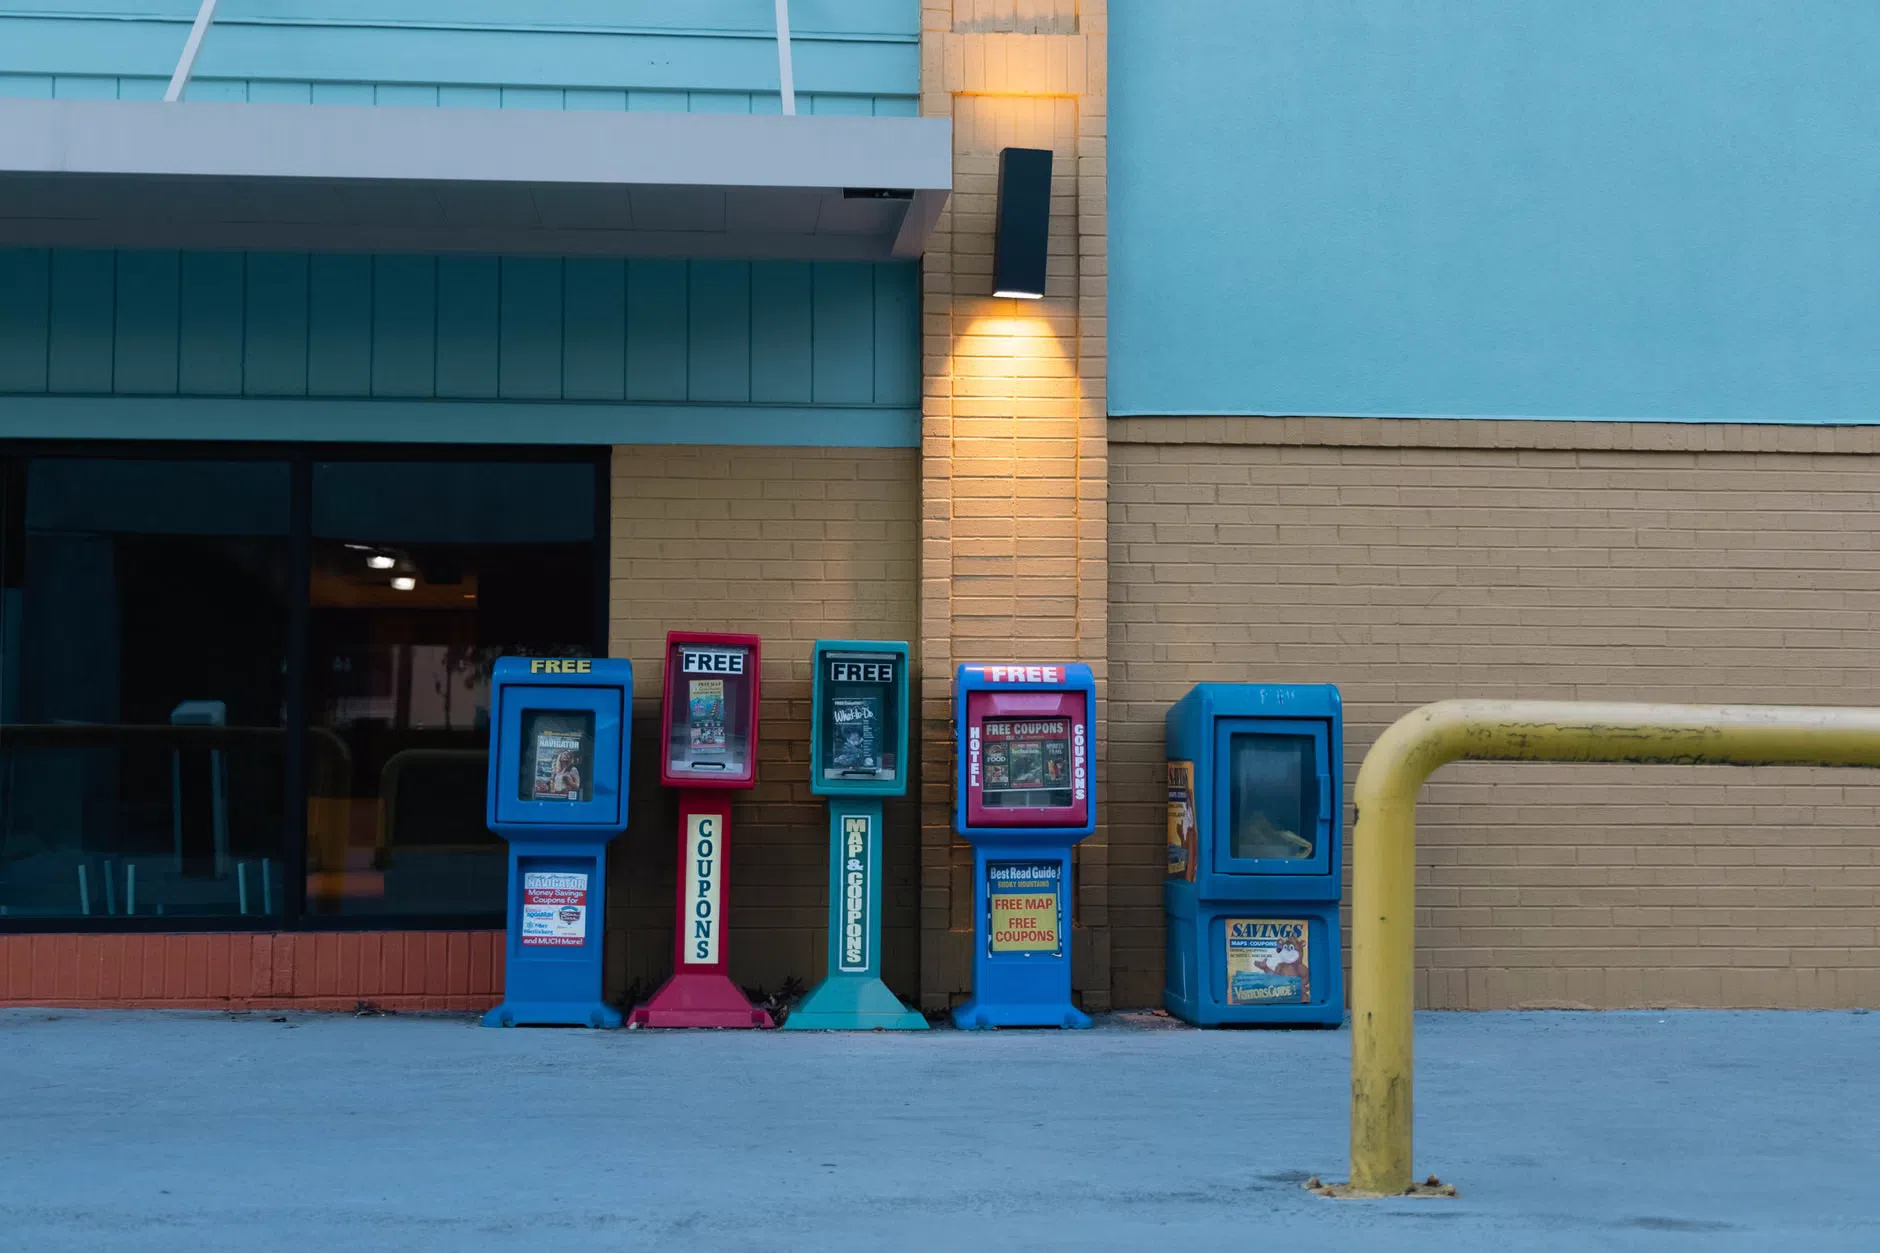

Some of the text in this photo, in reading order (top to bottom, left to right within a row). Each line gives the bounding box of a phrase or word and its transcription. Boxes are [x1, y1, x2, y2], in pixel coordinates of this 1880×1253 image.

[530, 659, 591, 674] FREE
[684, 653, 743, 672] FREE
[832, 663, 892, 682] FREE
[991, 666, 1058, 683] FREE
[986, 722, 1064, 736] FREE COUPONS
[539, 739, 580, 749] NAVIGATOR
[969, 726, 980, 787] HOTEL
[1074, 723, 1085, 801] COUPONS
[990, 866, 1056, 880] Best Read Guide
[527, 879, 586, 889] NAVIGATOR
[694, 819, 713, 959] COUPONS
[845, 818, 867, 963] MAP & COUPONS
[528, 889, 584, 898] Money Savings
[532, 896, 579, 905] Coupons for
[994, 898, 1053, 910] FREE MAP
[1008, 917, 1037, 929] FREE
[995, 930, 1055, 942] COUPONS
[1231, 922, 1304, 939] SAVINGS
[538, 937, 561, 945] MUCH
